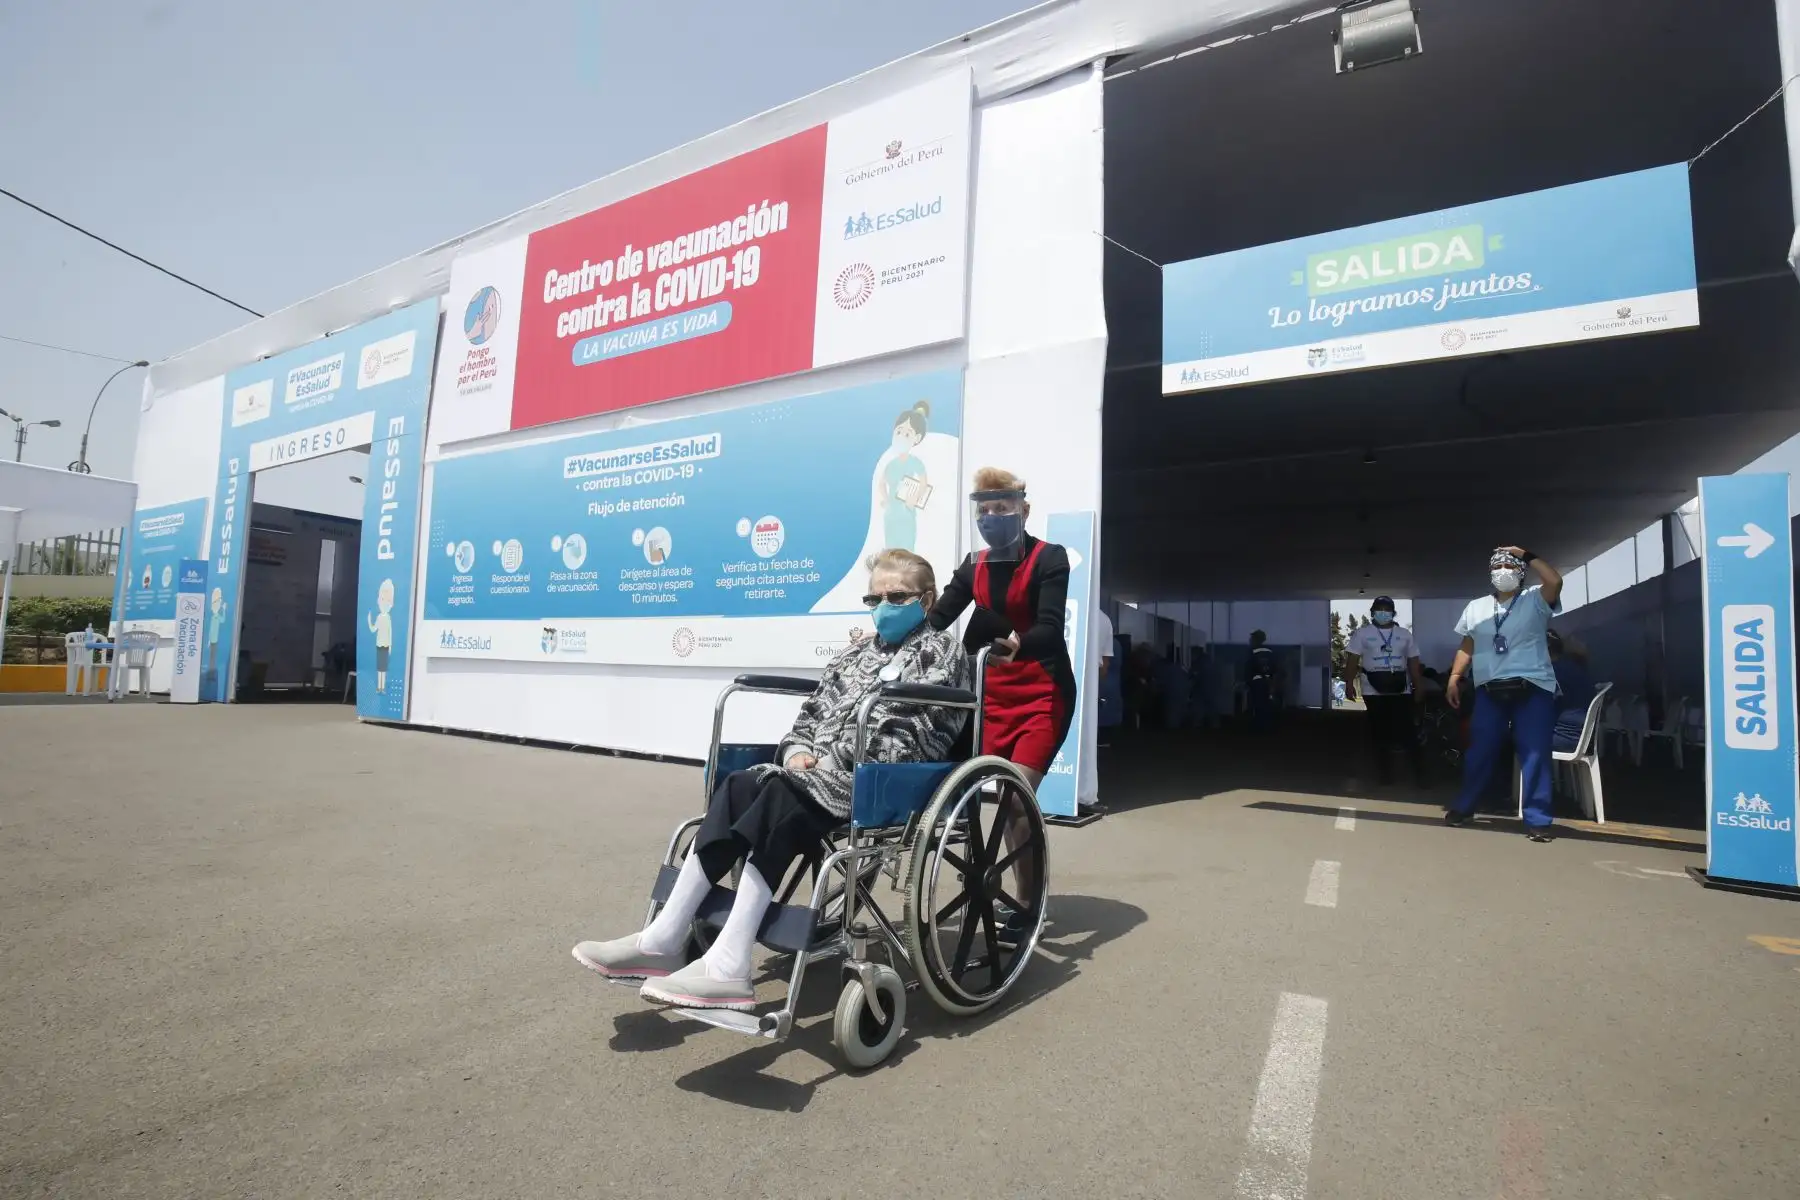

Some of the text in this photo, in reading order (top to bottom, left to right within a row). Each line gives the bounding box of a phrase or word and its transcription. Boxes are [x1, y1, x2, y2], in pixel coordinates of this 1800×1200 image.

[845, 145, 943, 186] Gobierno del Perú
[876, 196, 942, 231] EsSalud
[544, 199, 788, 303] Centro de vacunación
[881, 255, 946, 277] BICENTENARIO
[1316, 235, 1474, 288] SALIDA
[906, 270, 924, 282] 2021
[556, 245, 760, 338] contra la COVID-19
[1268, 306, 1301, 328] Lo
[1308, 285, 1434, 323] logramos
[1583, 319, 1626, 333] Gobierno
[1629, 317, 1643, 327] del
[582, 312, 717, 359] LA VACUNA ES VIDA
[467, 347, 489, 360] Pongo
[289, 359, 341, 384] #Vacunarse
[459, 361, 466, 373] el
[1204, 366, 1249, 381] EsSalud
[296, 376, 330, 397] EsSalud
[457, 375, 471, 388] por
[472, 370, 479, 381] el
[270, 427, 346, 462] INGRESO
[567, 436, 716, 474] #VacunarseEsSalud
[377, 416, 404, 560] EsSalud
[583, 464, 694, 492] contra la COVID-19
[588, 492, 685, 518] Flujo de atención
[218, 458, 240, 574] EsSalud
[653, 568, 659, 577] al
[661, 565, 679, 577] área
[681, 565, 692, 576] de
[759, 562, 769, 571] tu
[770, 558, 799, 570] fecha
[801, 557, 815, 568] de
[491, 571, 530, 584] Responde el
[550, 571, 566, 580] Pasa
[573, 570, 580, 579] la
[580, 571, 597, 579] zona
[715, 571, 820, 589] segunda cita antes de
[547, 581, 600, 592] de vacunación.
[618, 581, 656, 592] descanso
[664, 579, 693, 592] espera
[744, 587, 787, 599] retirarte.
[632, 593, 678, 603] 10 minutos.
[188, 618, 199, 657] Zona de
[457, 635, 491, 650] EsSalud
[561, 629, 586, 638] EsSalud
[177, 617, 189, 675] Vacunación
[815, 646, 842, 656] Gobie
[1734, 617, 1767, 736] SALIDA
[1716, 812, 1791, 831] EsSalud
